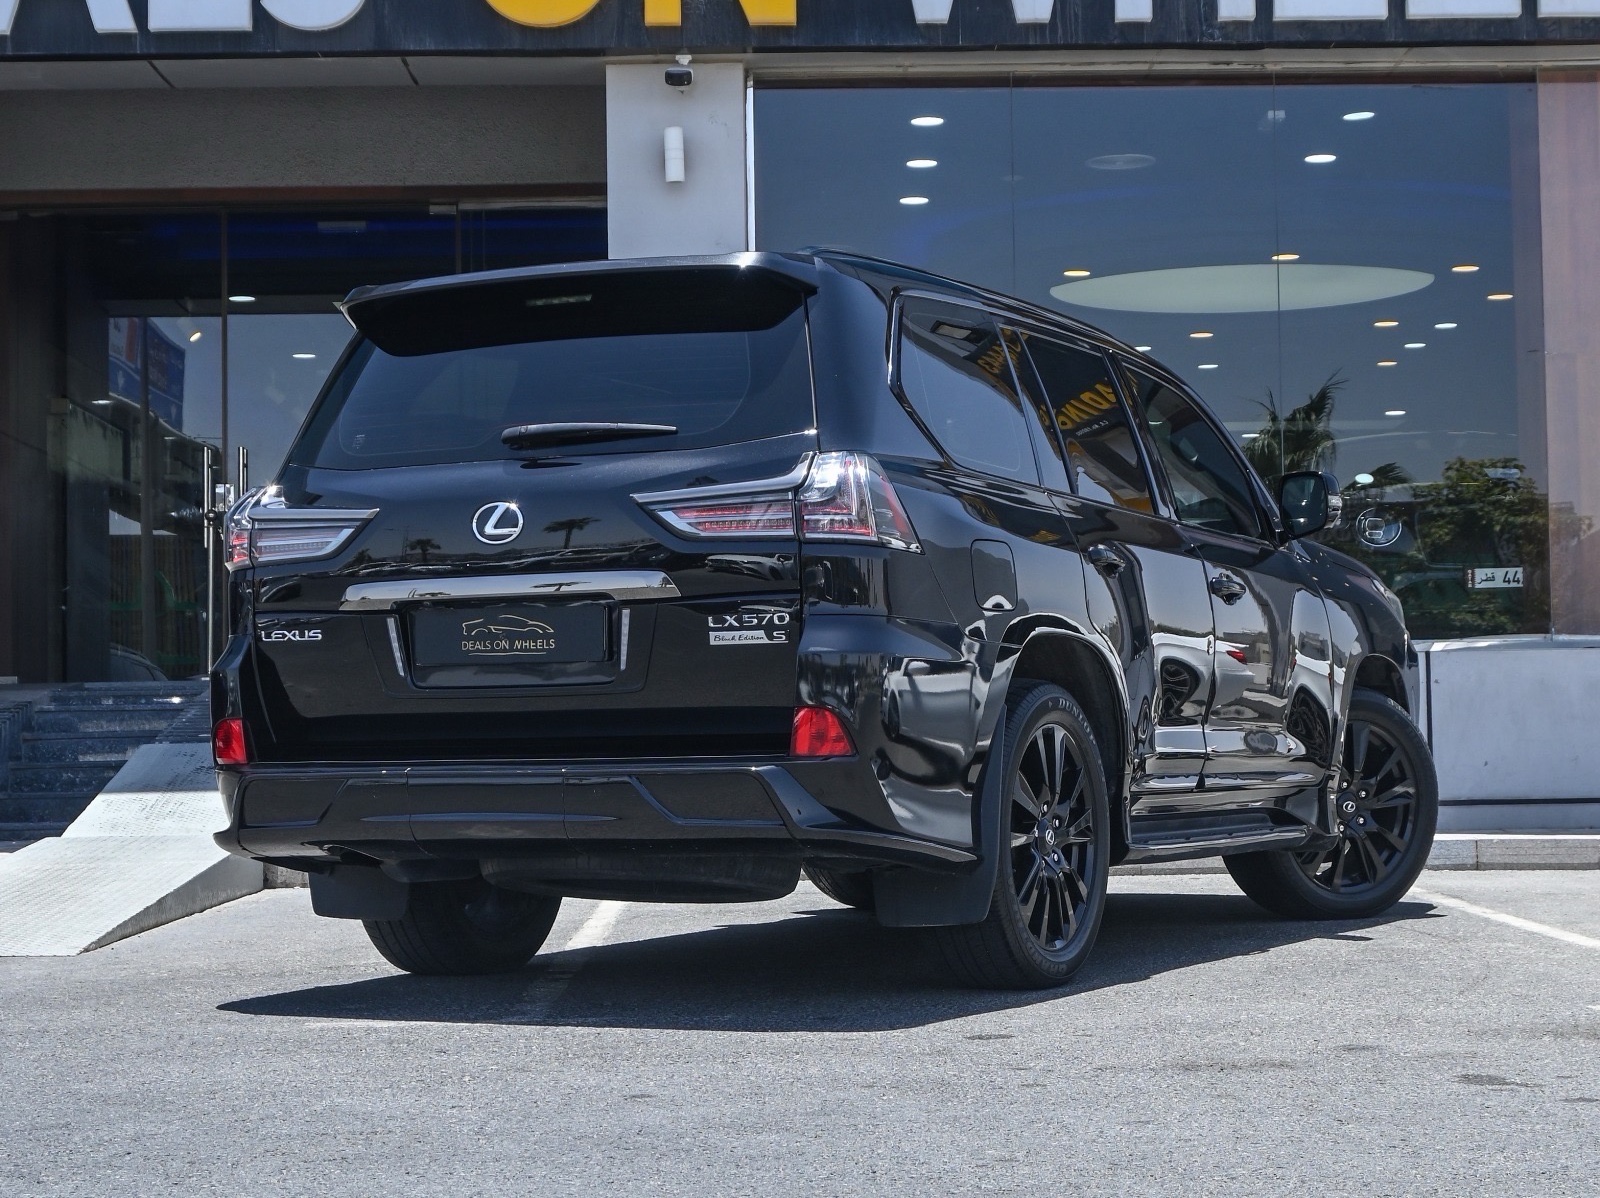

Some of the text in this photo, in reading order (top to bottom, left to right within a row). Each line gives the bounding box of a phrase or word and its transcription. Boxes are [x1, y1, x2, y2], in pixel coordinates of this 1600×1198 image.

[1476, 572, 1496, 584] قطر
[261, 629, 322, 641] LEXUS
[738, 633, 764, 641] Edition
[773, 631, 786, 641] S
[461, 640, 492, 651] DEALS
[493, 639, 510, 650] ON
